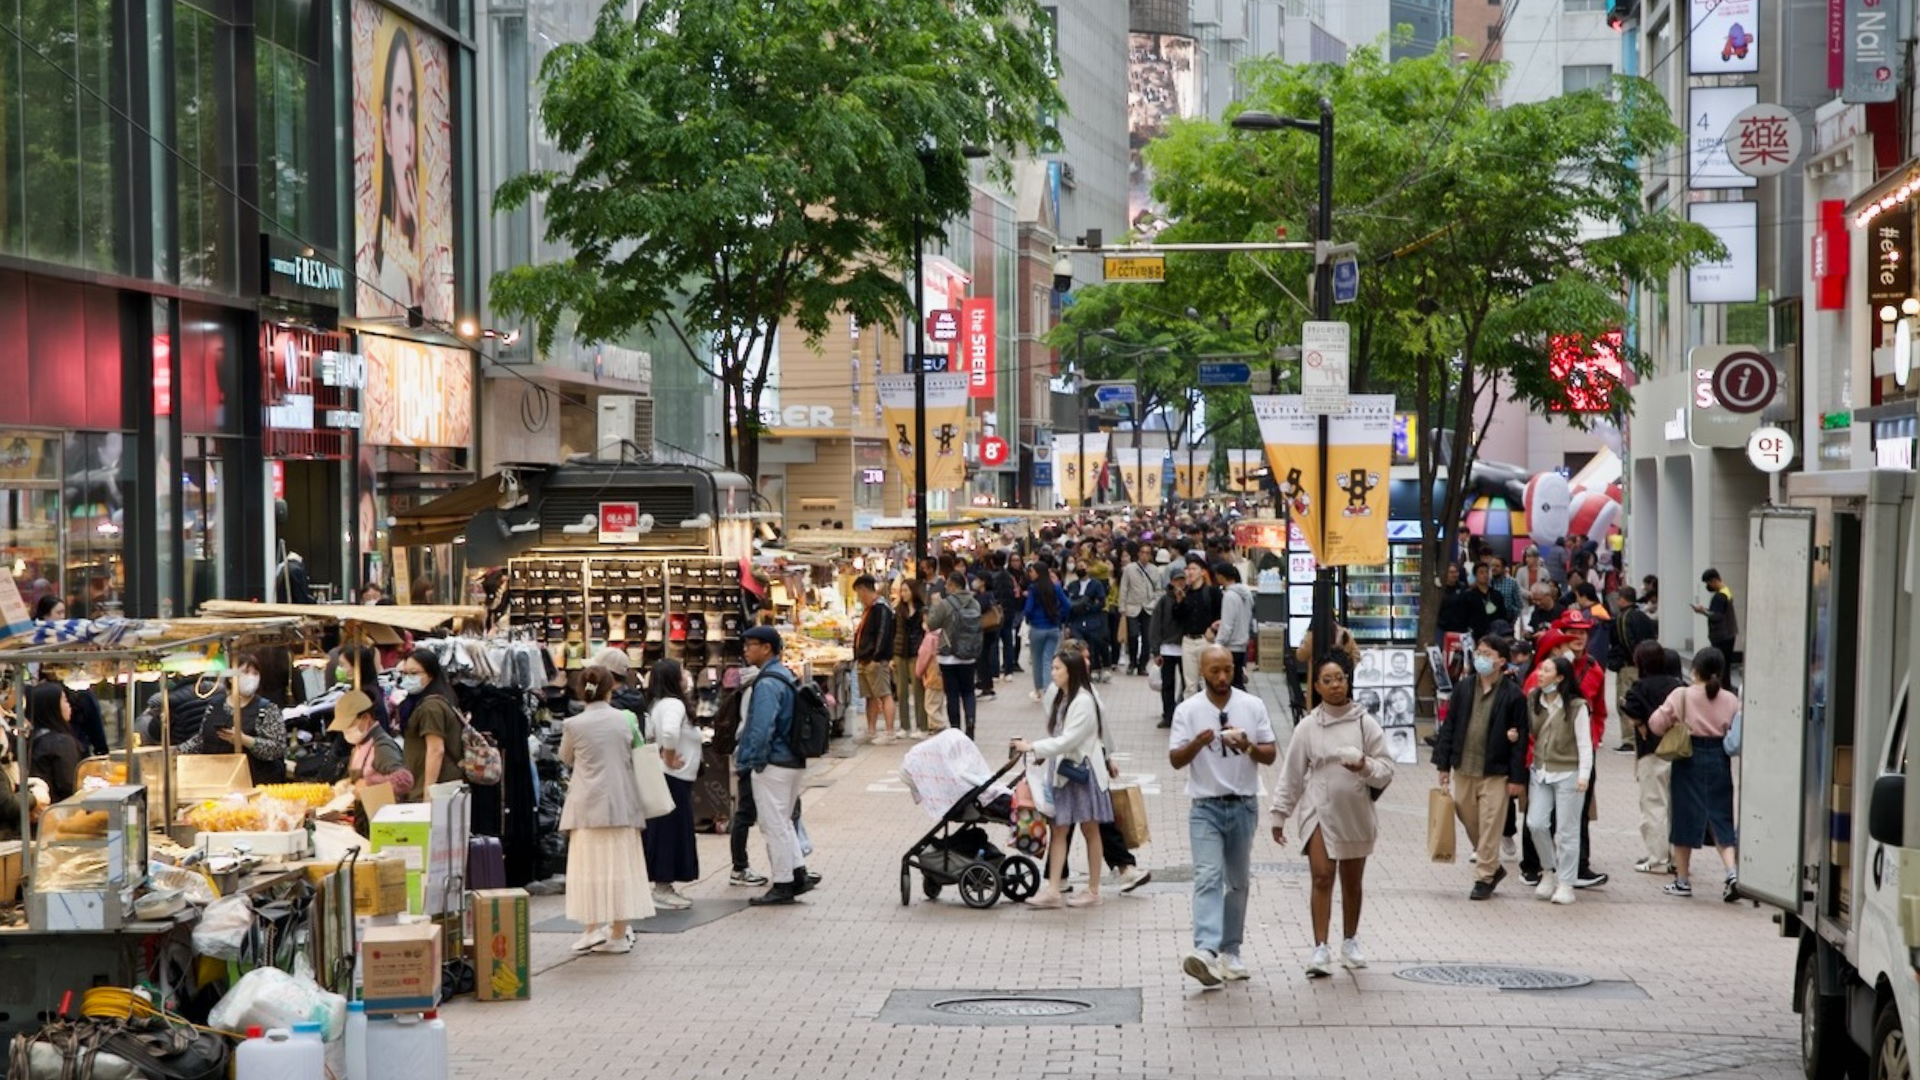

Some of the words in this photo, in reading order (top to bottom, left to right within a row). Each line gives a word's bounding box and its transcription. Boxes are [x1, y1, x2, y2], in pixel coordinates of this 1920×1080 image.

[1856, 11, 1886, 62] Nail
[1697, 112, 1709, 131] 4
[1739, 116, 1790, 166] 藥
[1758, 437, 1784, 464] 약
